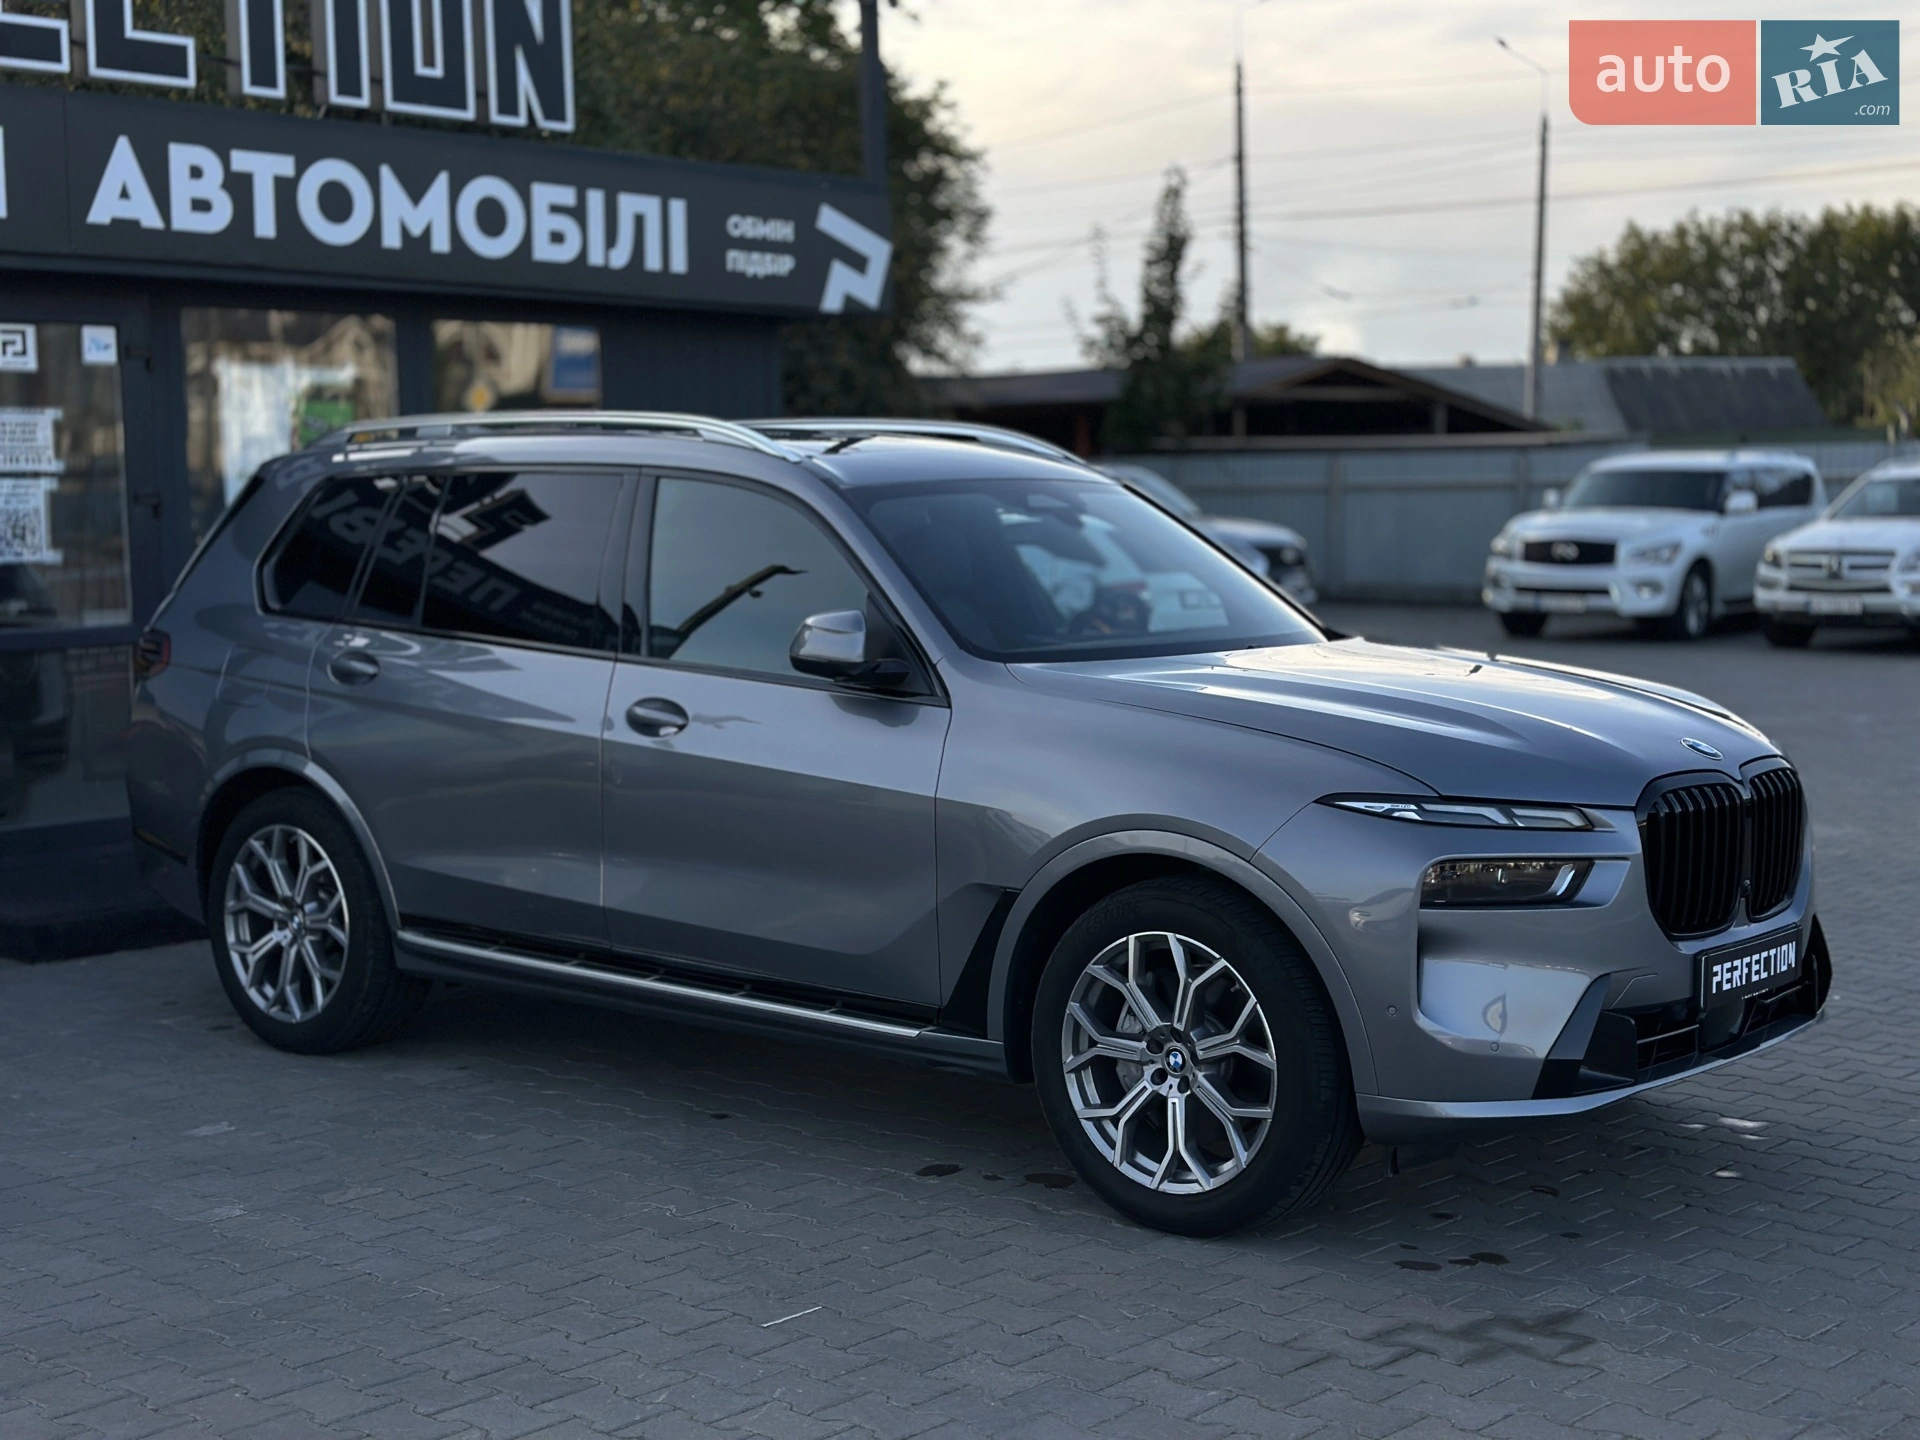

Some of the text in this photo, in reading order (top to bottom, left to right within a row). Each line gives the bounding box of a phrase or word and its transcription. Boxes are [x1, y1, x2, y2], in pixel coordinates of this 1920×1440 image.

[86, 134, 689, 275] АВТОМОБІЛІ
[725, 213, 796, 244] ОБМІН
[725, 248, 797, 279] ПІДБІР
[1711, 940, 1797, 995] PERFECTION
